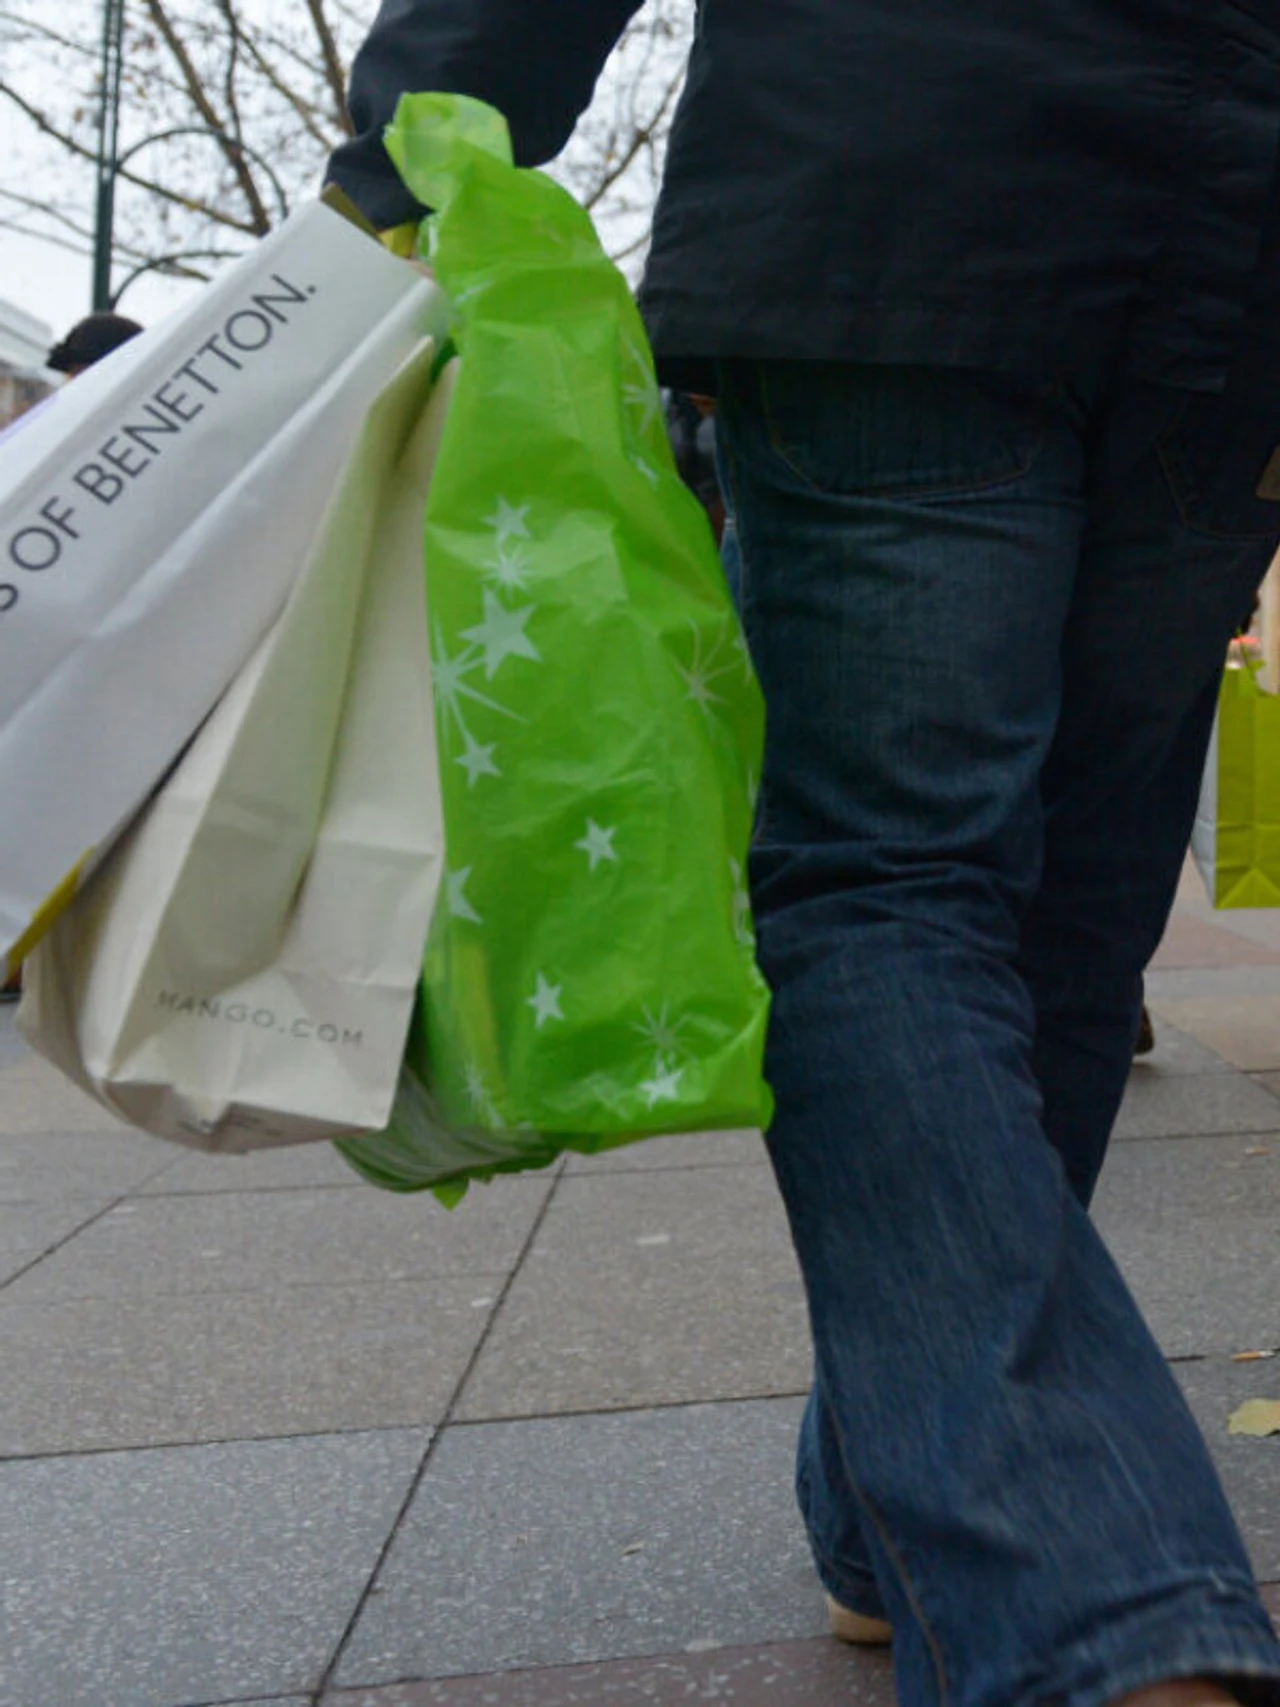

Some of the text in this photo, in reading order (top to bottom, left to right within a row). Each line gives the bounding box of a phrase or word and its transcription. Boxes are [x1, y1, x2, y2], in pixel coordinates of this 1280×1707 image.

[9, 273, 317, 572] OF BENETTON.
[156, 989, 364, 1048] MANGO.COM
